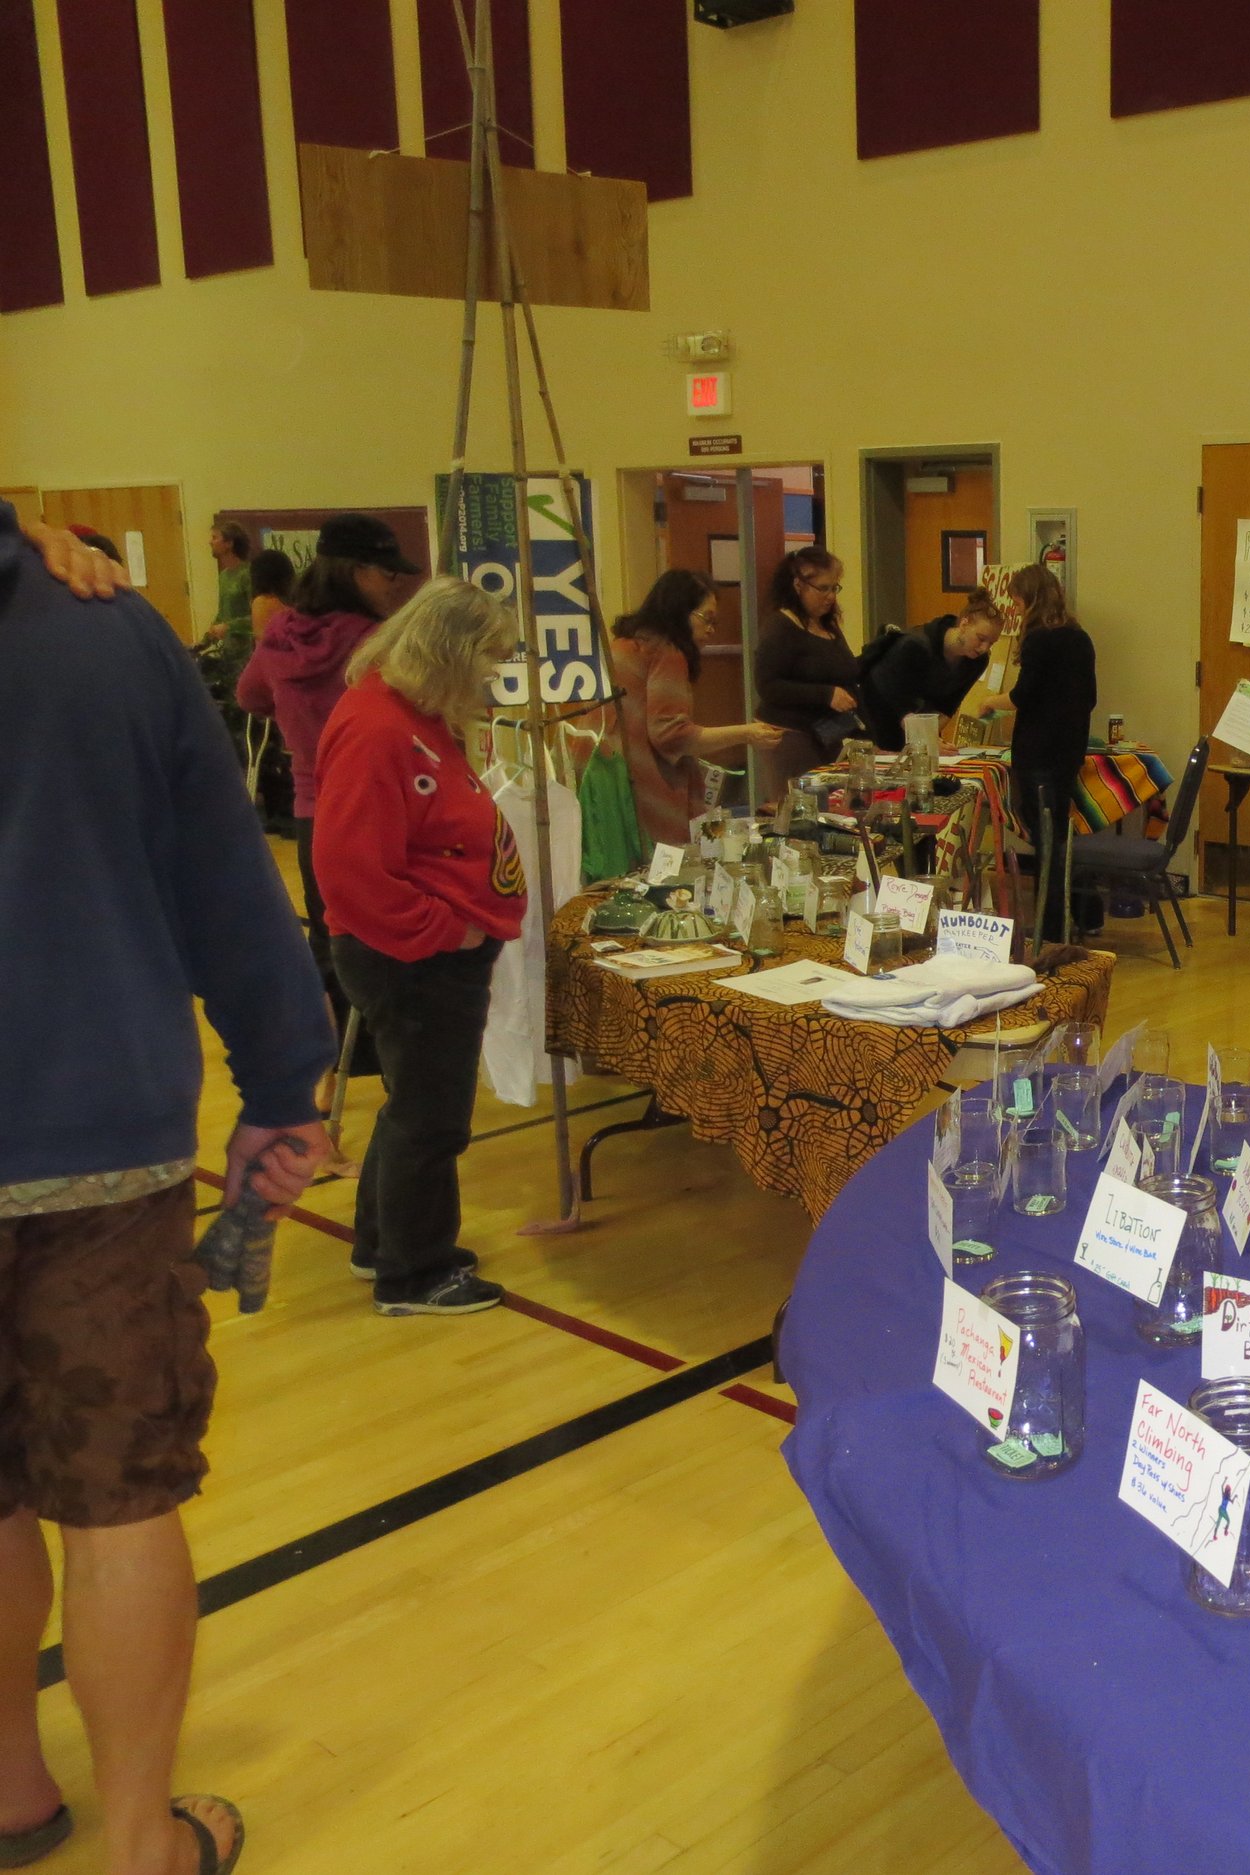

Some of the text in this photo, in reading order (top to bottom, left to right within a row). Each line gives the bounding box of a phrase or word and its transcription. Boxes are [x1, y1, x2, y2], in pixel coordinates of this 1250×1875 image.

[692, 376, 717, 408] EXIT
[471, 475, 487, 551] Farmers!
[488, 481, 501, 543] Family
[502, 478, 518, 548] Support
[532, 560, 597, 703] YES
[940, 915, 1010, 938] HUMBOLDT
[956, 1307, 995, 1360] Pachanga
[959, 1341, 992, 1378] Mexican
[967, 1370, 1008, 1406] Restaurant
[1131, 1439, 1137, 1448] 2
[1141, 1393, 1206, 1460] Far North
[1137, 1420, 1193, 1492] Climbing
